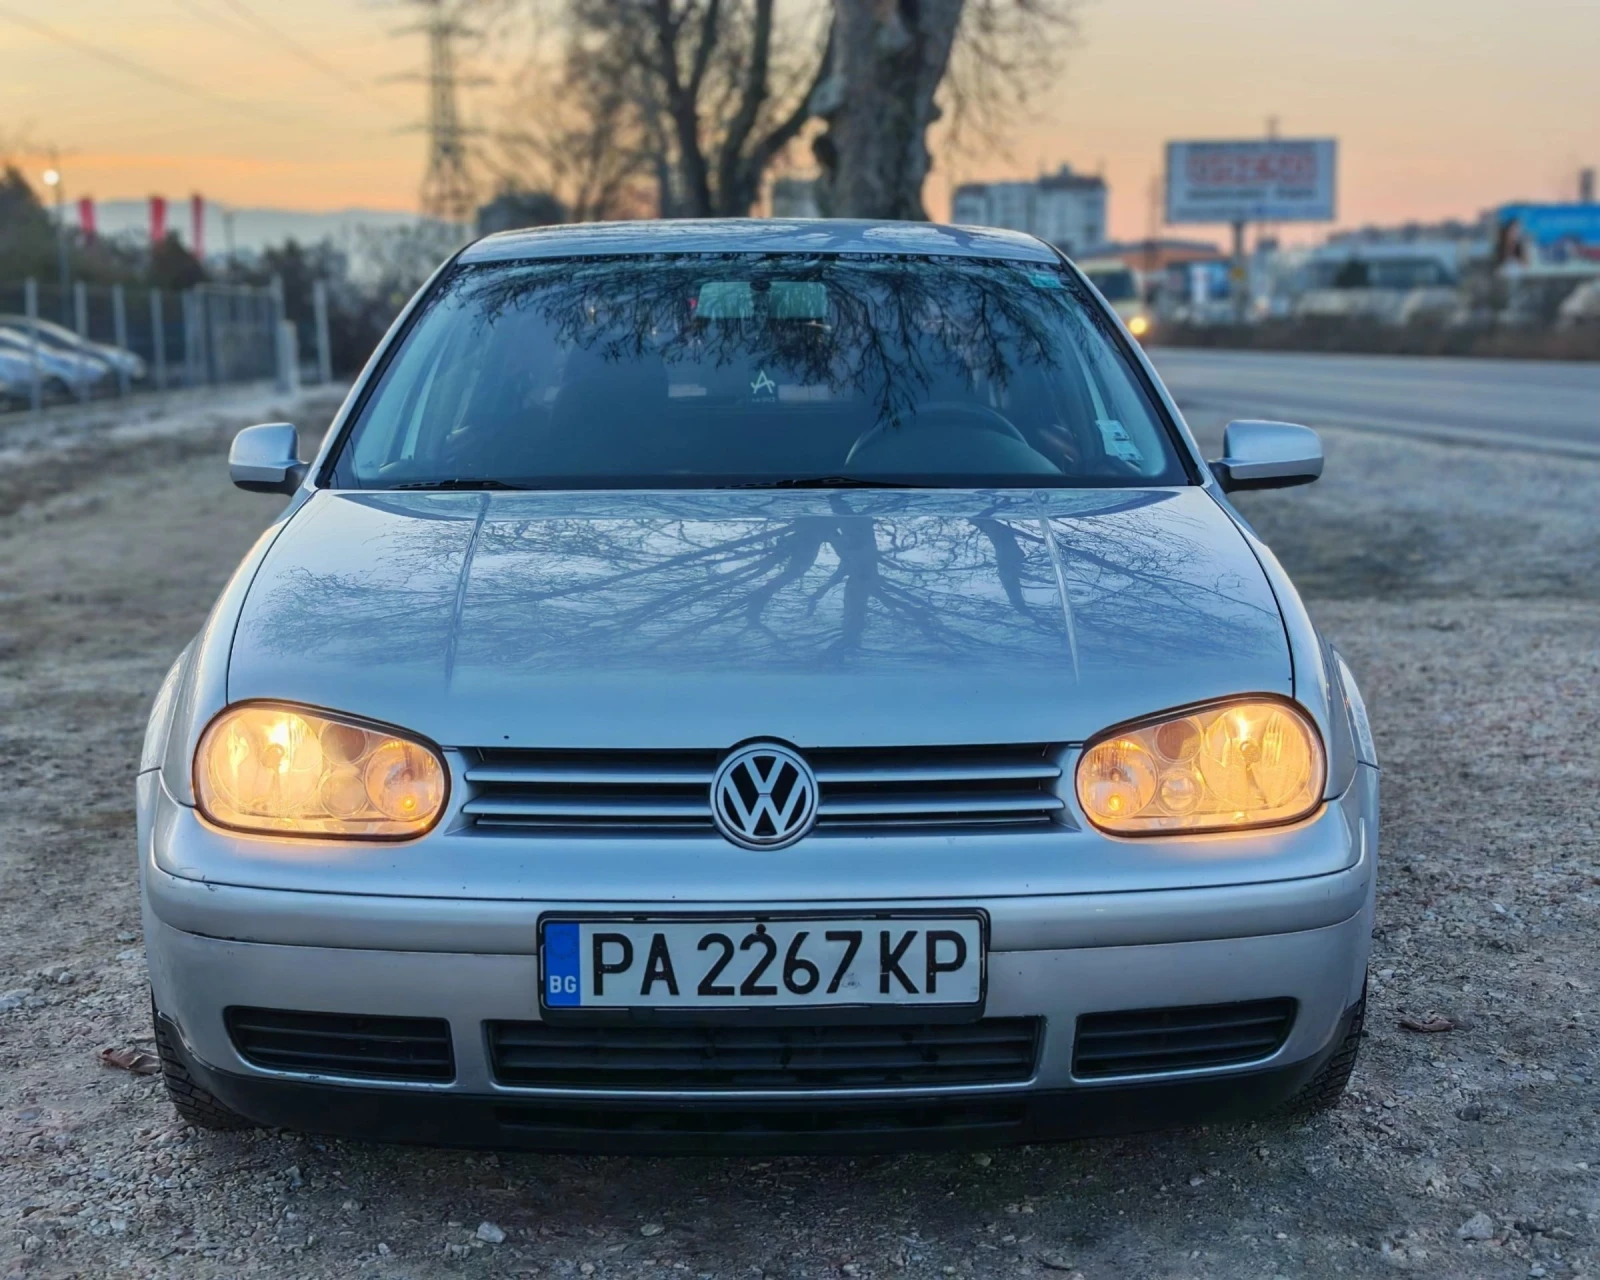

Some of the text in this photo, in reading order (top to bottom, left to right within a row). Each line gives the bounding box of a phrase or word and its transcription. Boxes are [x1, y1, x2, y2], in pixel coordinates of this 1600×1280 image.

[716, 747, 813, 840] VW
[549, 975, 577, 994] BG
[592, 929, 967, 996] PA 2267 KP
